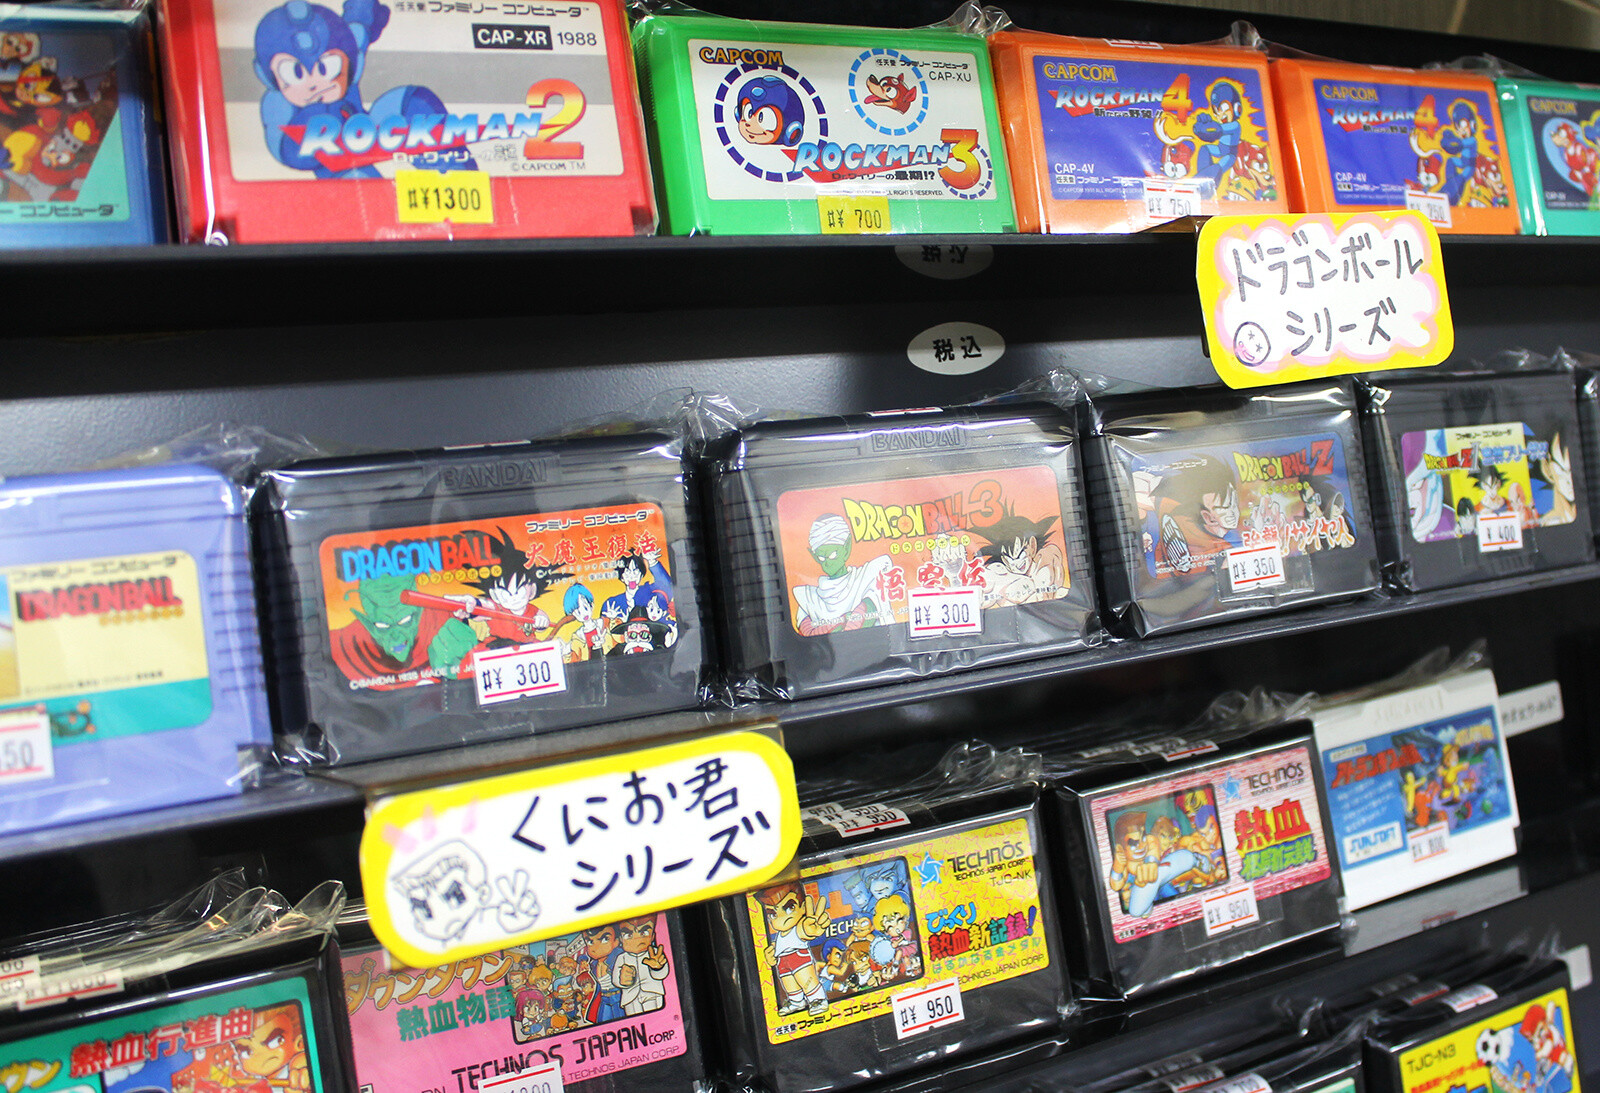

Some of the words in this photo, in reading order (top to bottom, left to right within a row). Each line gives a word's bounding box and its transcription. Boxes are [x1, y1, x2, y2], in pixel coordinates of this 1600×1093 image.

[477, 28, 548, 46] CAP-XR
[557, 31, 598, 46] 1988
[700, 47, 783, 65] CAPCOM
[928, 71, 972, 82] CAP-XU
[1042, 62, 1118, 83] CAPCOM
[1055, 85, 1164, 108] ROCKMAN
[1161, 73, 1193, 125] 4
[1321, 85, 1378, 101] CAPCOM
[298, 111, 543, 158] ROCKMAN
[523, 77, 588, 161] 2
[1333, 105, 1415, 125] ROCKMAN
[1414, 94, 1439, 139] 4
[1530, 99, 1577, 114] CAPCOM
[792, 142, 951, 173] ROCKMAN
[938, 128, 981, 190] 3
[1055, 163, 1094, 174] CAP-4V
[854, 209, 882, 229] 700
[1169, 198, 1192, 216] 750
[1233, 230, 1424, 302] ドラゴンボール
[1286, 297, 1397, 356] シリーズ
[933, 335, 982, 362] 税込
[873, 428, 962, 451] BANDAI
[1311, 439, 1334, 476] Z
[442, 459, 548, 491] BANDAI
[526, 520, 581, 533] ファミリー
[584, 510, 648, 527] コンピュータ
[842, 497, 925, 542] DRAGON
[963, 480, 1003, 527] 3
[890, 535, 970, 555] ドラゴンボール
[1253, 557, 1276, 576] 350
[941, 604, 970, 624] 300
[516, 661, 551, 686] 300
[511, 757, 740, 852] くにお君
[866, 811, 897, 824] 950
[1234, 798, 1311, 850] 熱血
[571, 811, 771, 911] シリーズ
[990, 869, 1033, 887] TJC-NK
[925, 902, 977, 933] びっくり
[1229, 899, 1250, 919] 950
[928, 904, 1037, 962] 熱血新記録!
[992, 960, 1020, 976] JAPAN
[396, 985, 516, 1042] 熱血物語
[927, 996, 954, 1019] 950
[70, 1006, 255, 1079] 熱血行進曲
[572, 1022, 648, 1065] JAPAN
[568, 1062, 616, 1081] TECHNOS
[618, 1054, 650, 1069] JAPAN
[1406, 1043, 1457, 1074] TJC-N3
